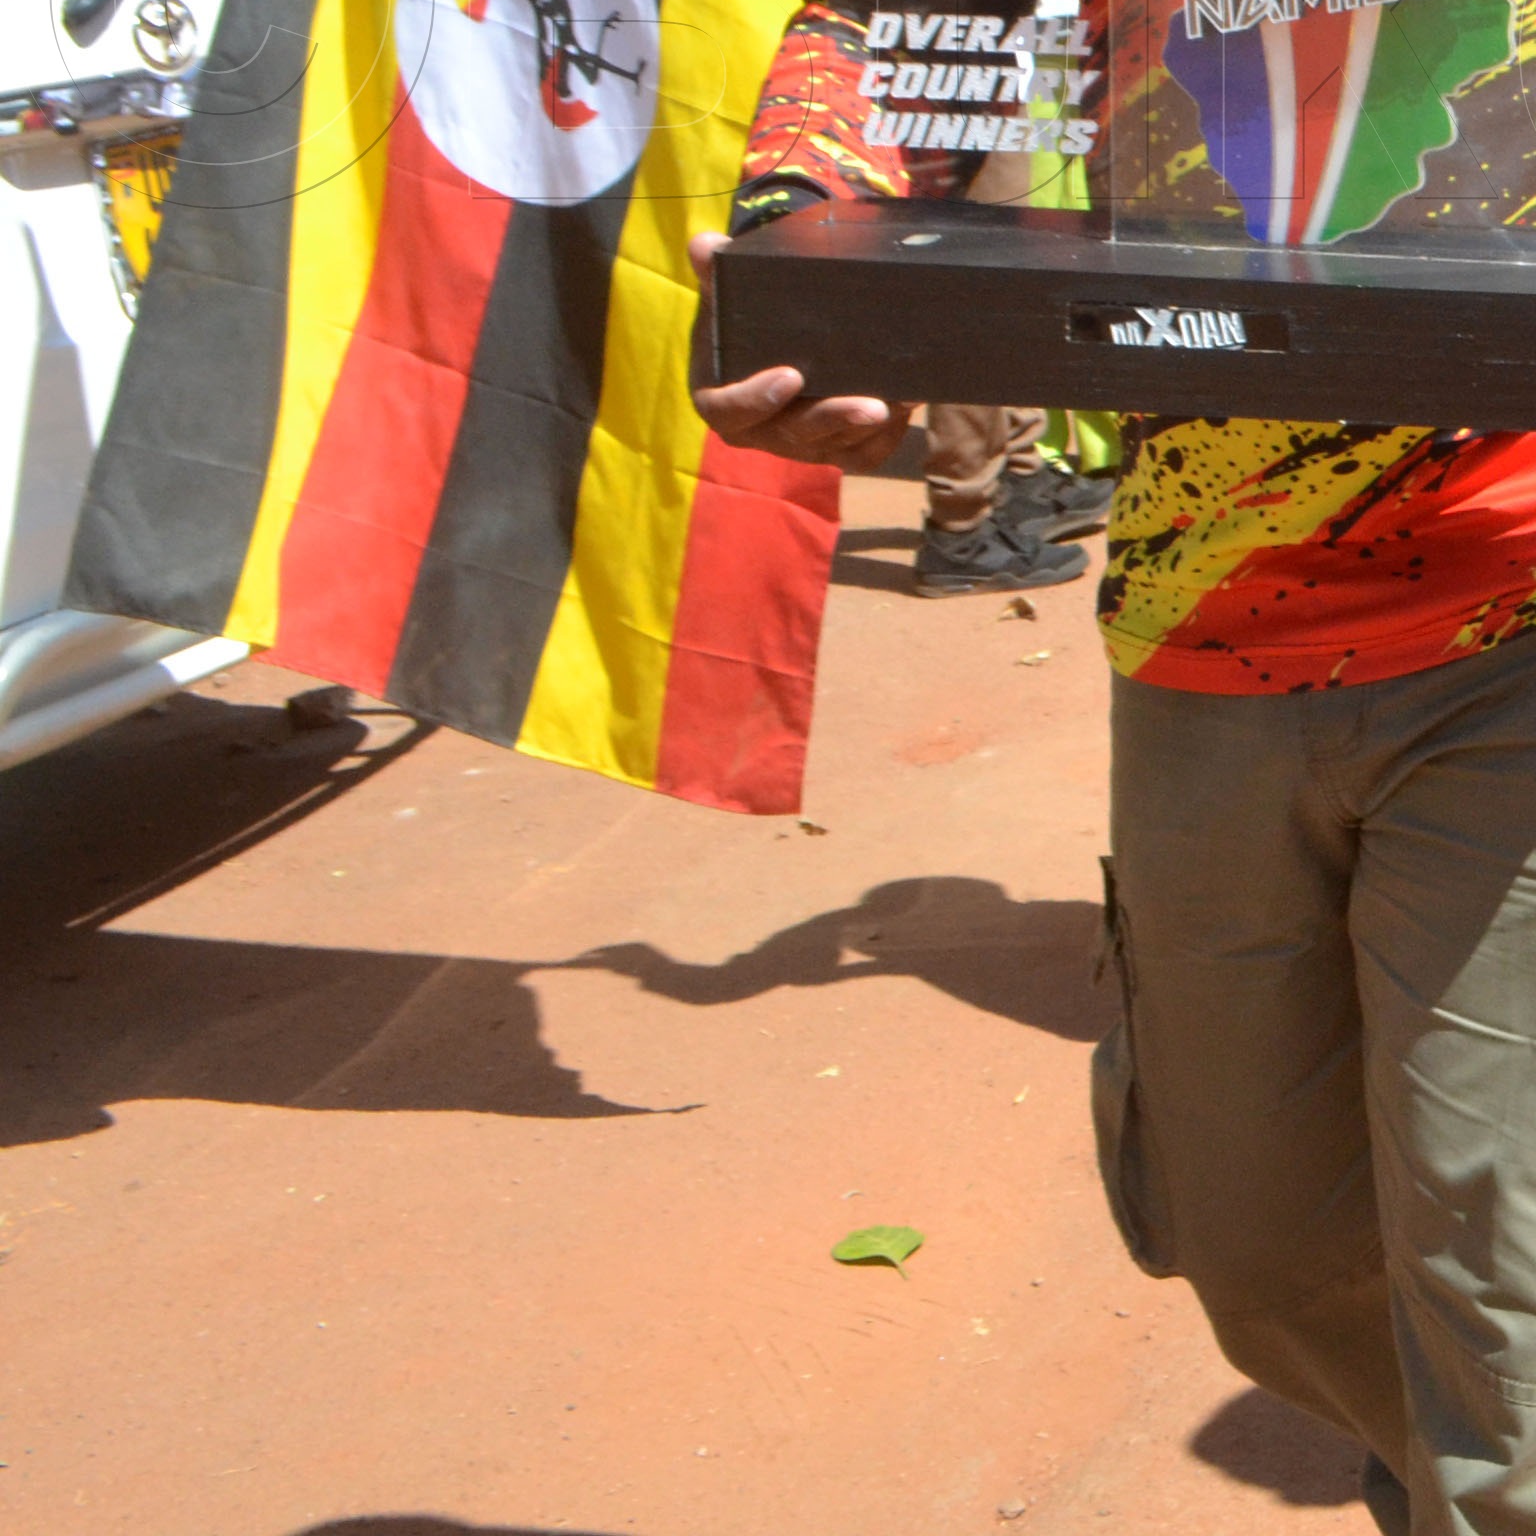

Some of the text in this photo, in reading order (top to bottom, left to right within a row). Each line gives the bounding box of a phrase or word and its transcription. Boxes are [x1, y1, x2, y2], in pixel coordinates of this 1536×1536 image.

[864, 11, 1093, 56] OVERALL
[857, 60, 1103, 106] COUNTRY
[861, 110, 1100, 156] WINNERS
